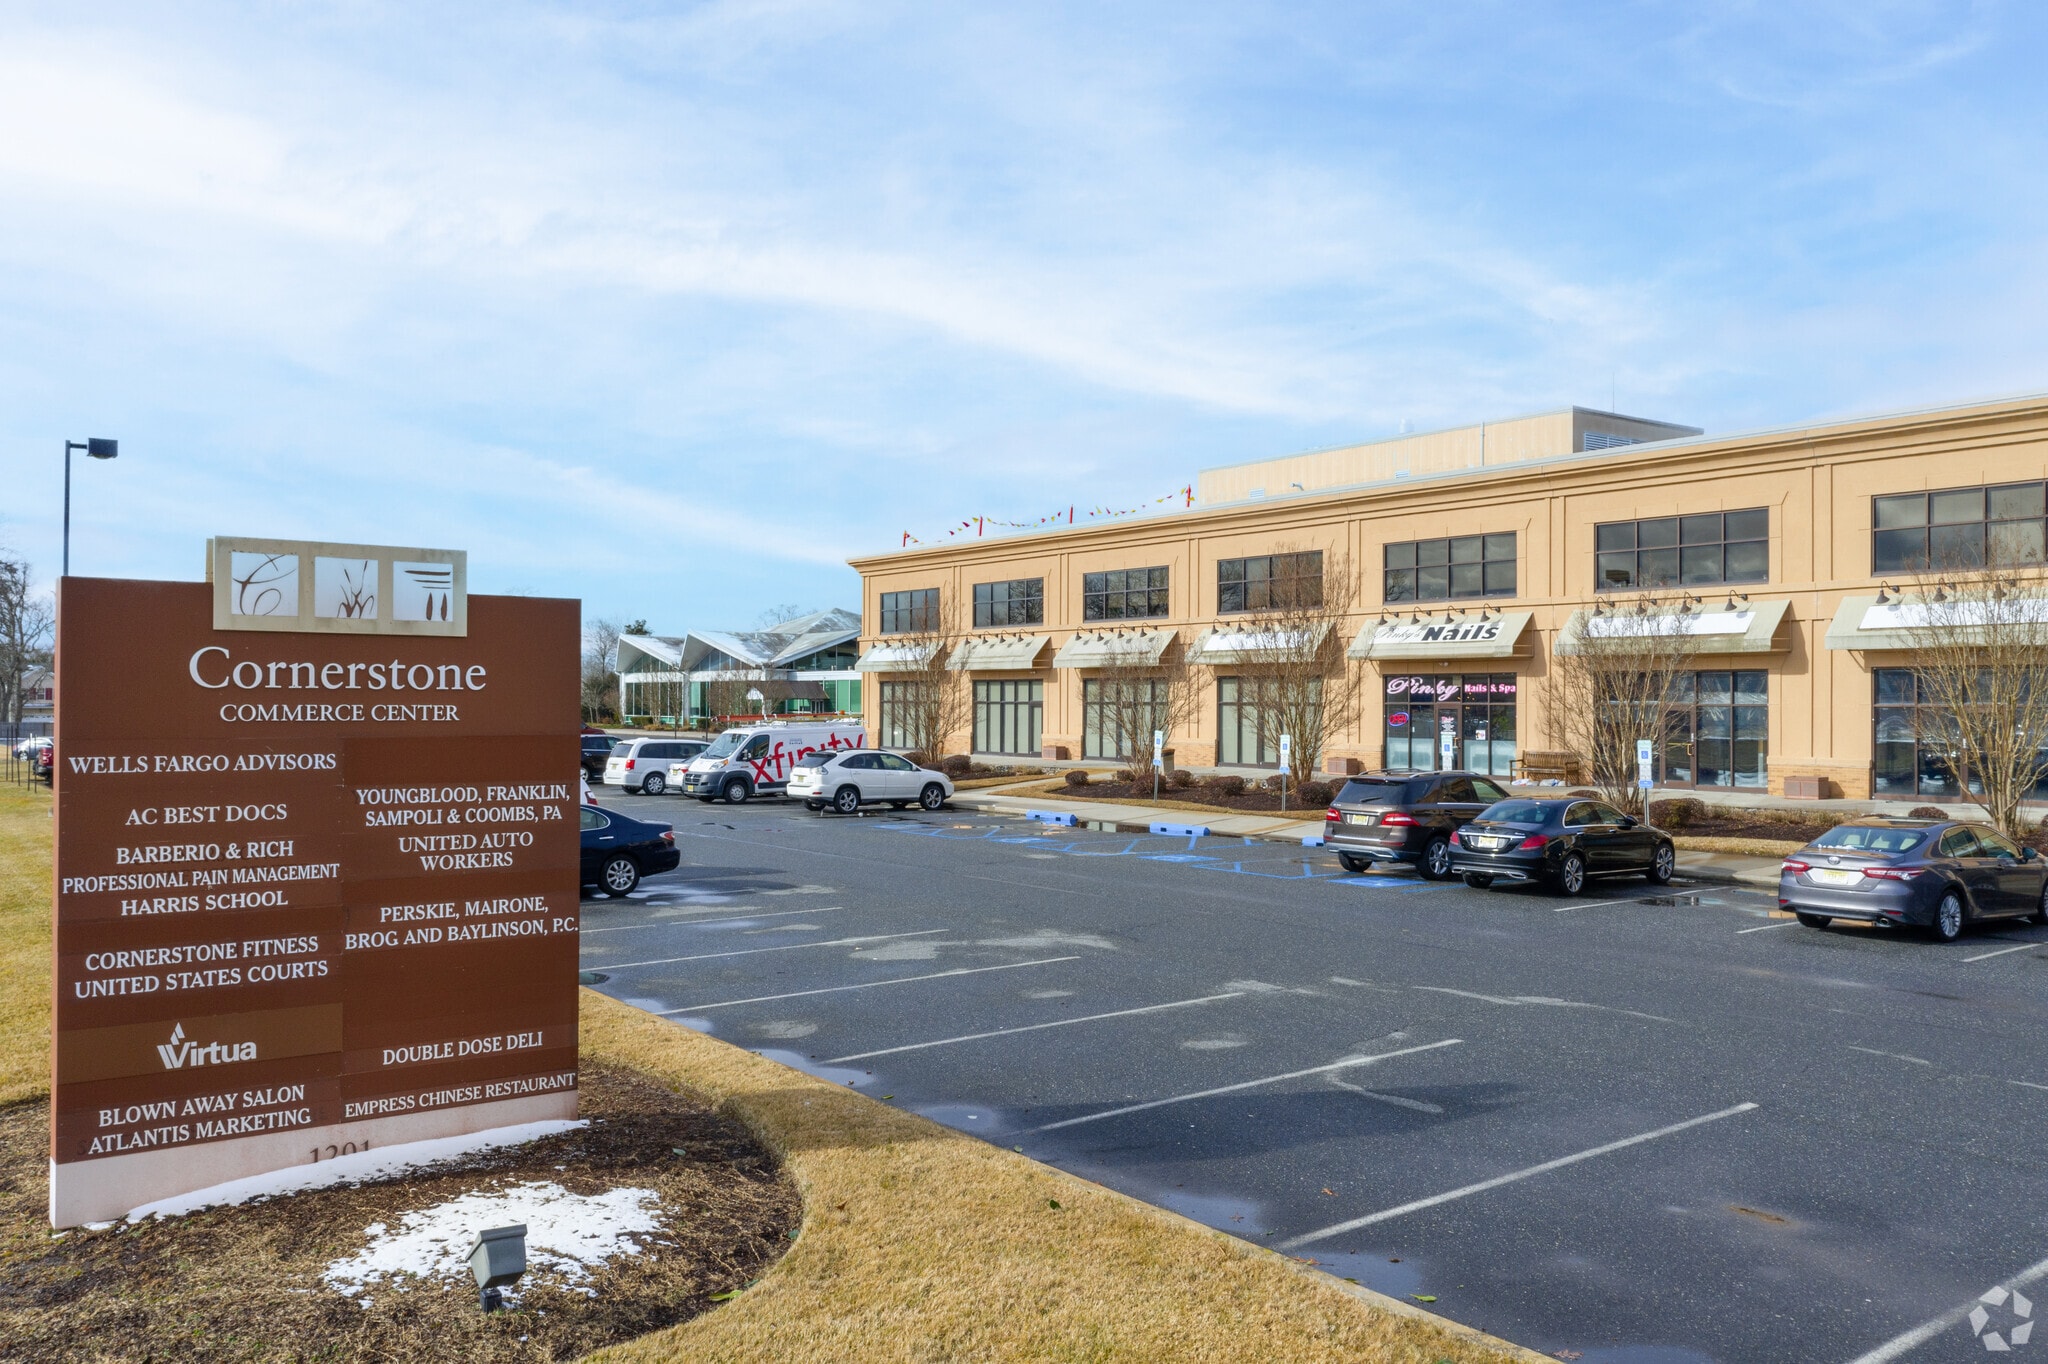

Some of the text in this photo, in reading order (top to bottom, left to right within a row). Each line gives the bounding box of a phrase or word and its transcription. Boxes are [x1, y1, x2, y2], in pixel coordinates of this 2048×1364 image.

[1421, 624, 1499, 641] Nails
[189, 646, 487, 691] Cornerstone
[1464, 683, 1488, 693] Nails
[1490, 684, 1498, 693] &
[1498, 683, 1517, 694] Spa
[219, 703, 460, 722] COMMERCE CENTER
[68, 753, 337, 774] WELLS FARGO ADVISORS
[749, 732, 864, 785] xfint
[356, 784, 570, 805] YOUNGBLOOD, FRANKLIN,
[125, 803, 289, 826] AC BEST DOCS
[365, 805, 563, 827] SAMPOLI & COOMBS, PA
[116, 840, 294, 865] BARBERIO & RICH
[398, 831, 534, 853] UNITED AUTO
[419, 851, 514, 871] WORKERS
[62, 863, 340, 894] PROFESSIONAL PAIN MANAGEMENT
[120, 890, 289, 916] HARRIS SCHOOL
[380, 896, 549, 923] PERSKIE, MAIRONE,
[345, 916, 579, 950] BROG AND BAYLINSON, P.C.
[85, 935, 319, 971] CORNERSTONE FITNESS
[74, 959, 329, 999] UNITED STATES COURTS
[156, 1040, 257, 1070] Virtua
[382, 1031, 543, 1066] DOUBLE DOSE DELI
[98, 1084, 305, 1128] BLOWN AWAY SALON
[345, 1072, 576, 1118] EMPRESS CHINESE RESTAURANT
[87, 1107, 312, 1155] ATLANTIS MARKETING
